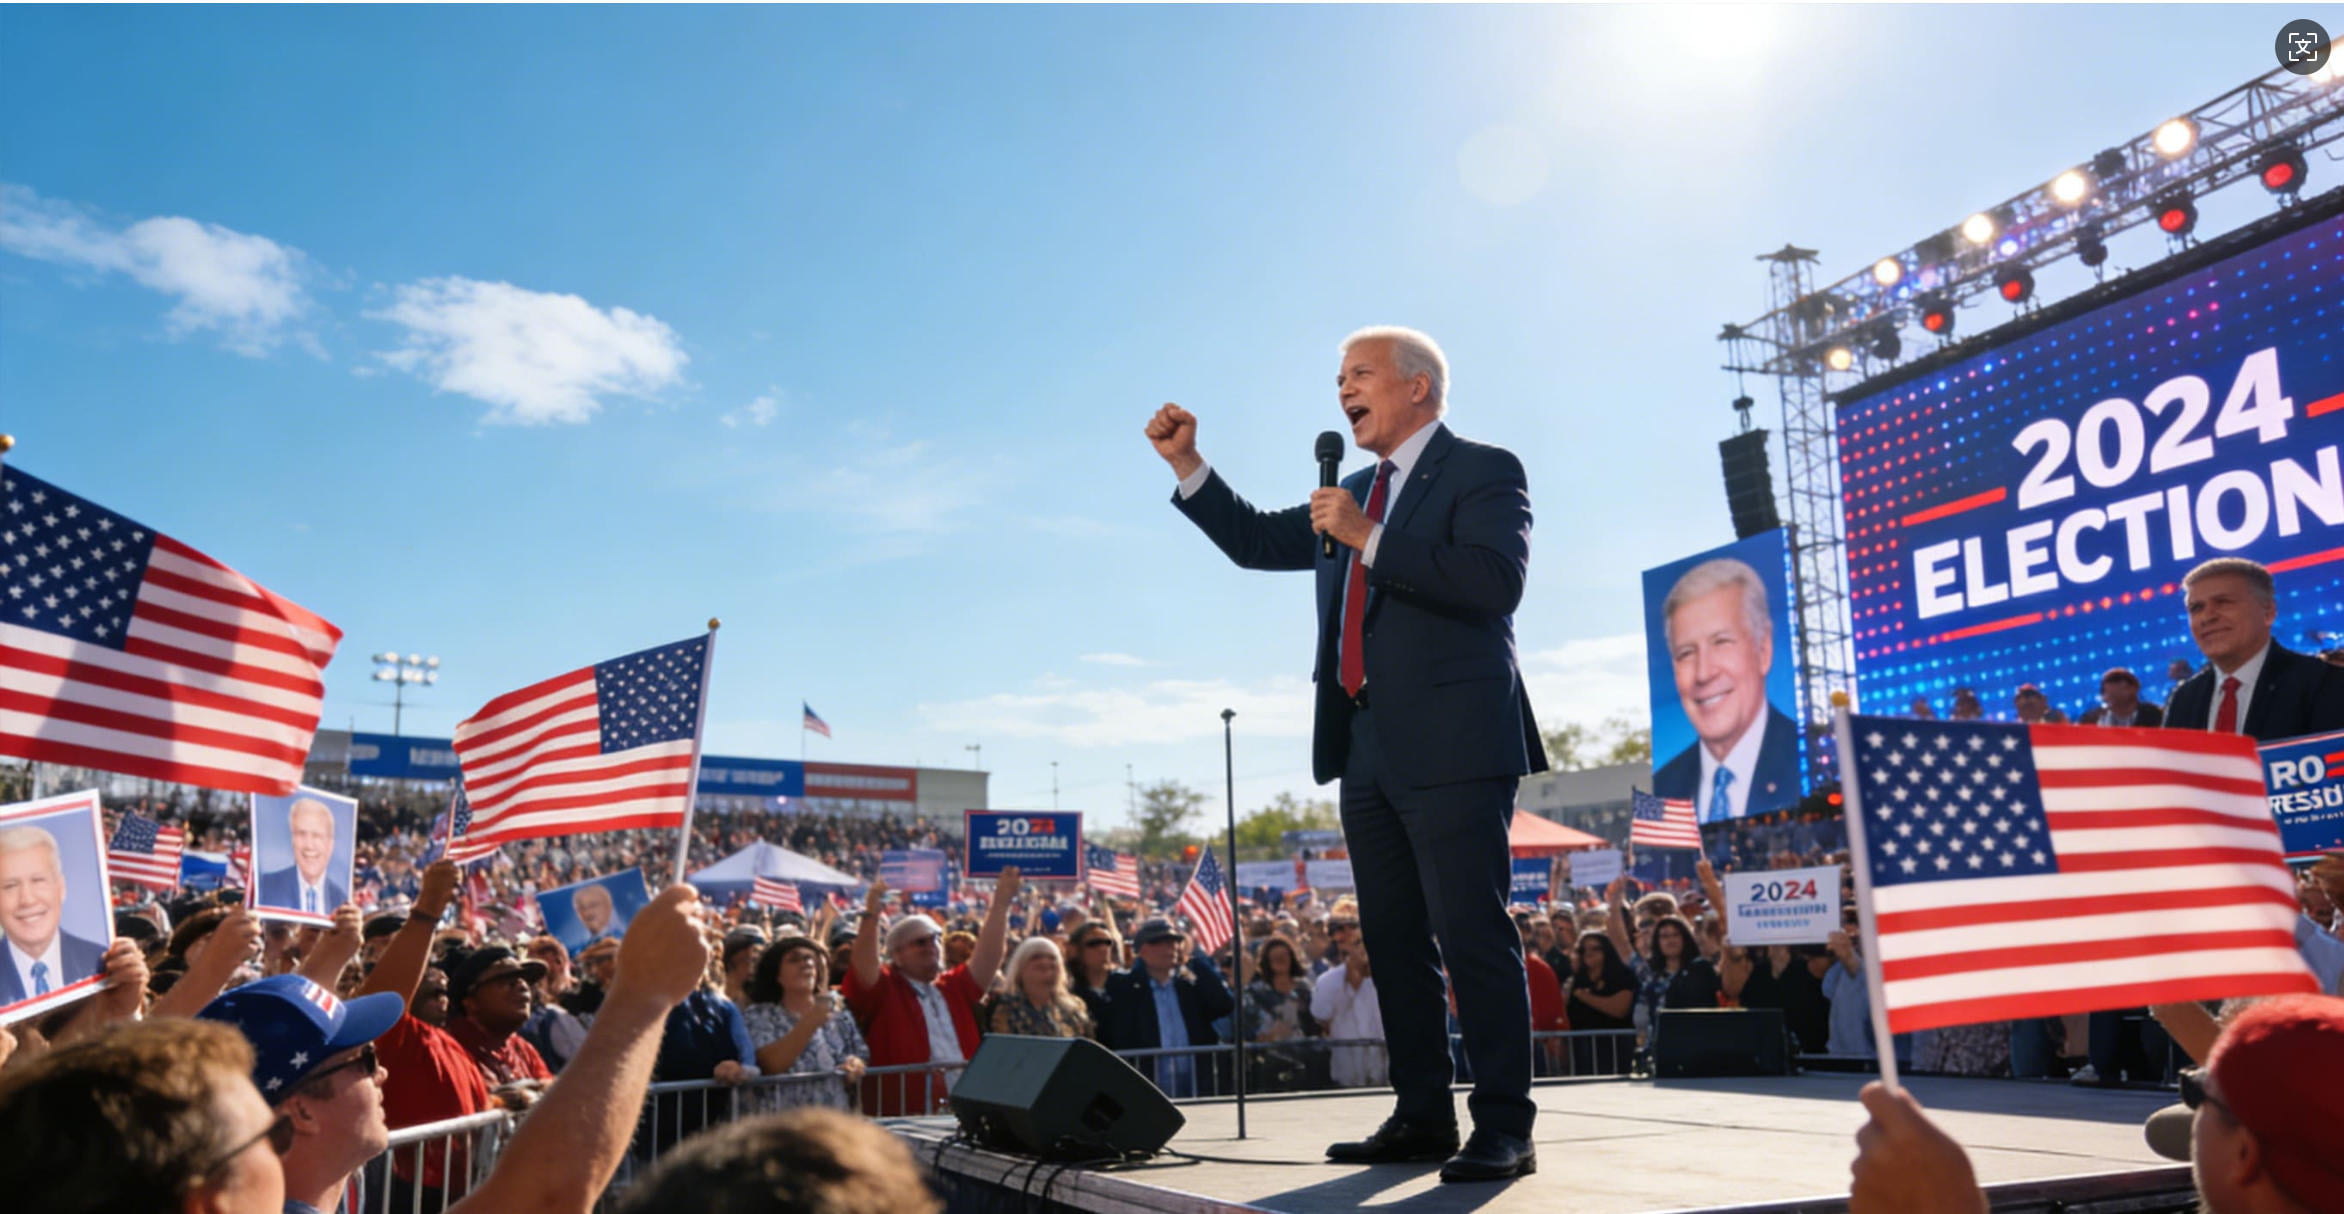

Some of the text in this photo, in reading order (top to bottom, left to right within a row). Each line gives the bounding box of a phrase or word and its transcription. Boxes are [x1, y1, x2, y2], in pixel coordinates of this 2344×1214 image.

[2011, 346, 2295, 511] 2024
[1912, 445, 2344, 620] ELECTION
[1750, 878, 1818, 903] 2024
